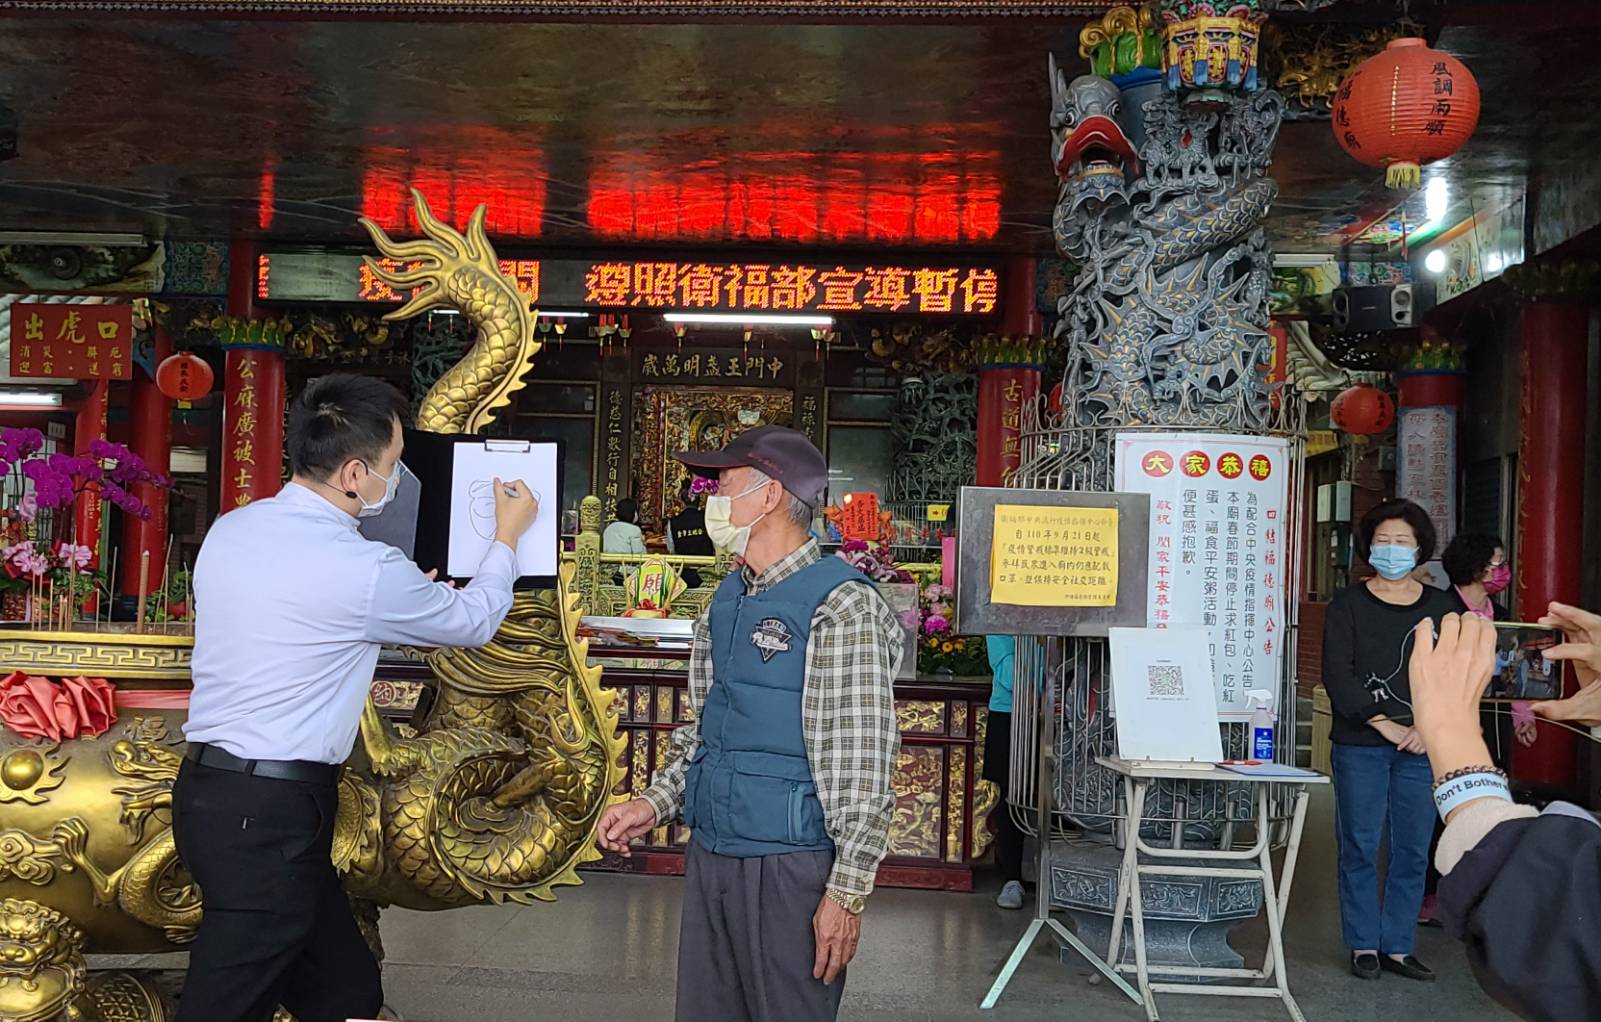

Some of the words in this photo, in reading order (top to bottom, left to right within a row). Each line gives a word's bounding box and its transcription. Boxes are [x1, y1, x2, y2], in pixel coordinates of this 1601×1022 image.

[1422, 61, 1453, 136] 風調雨順
[585, 262, 998, 312] 遵照衛福部宣導暫停
[1464, 778, 1502, 790] Bother
